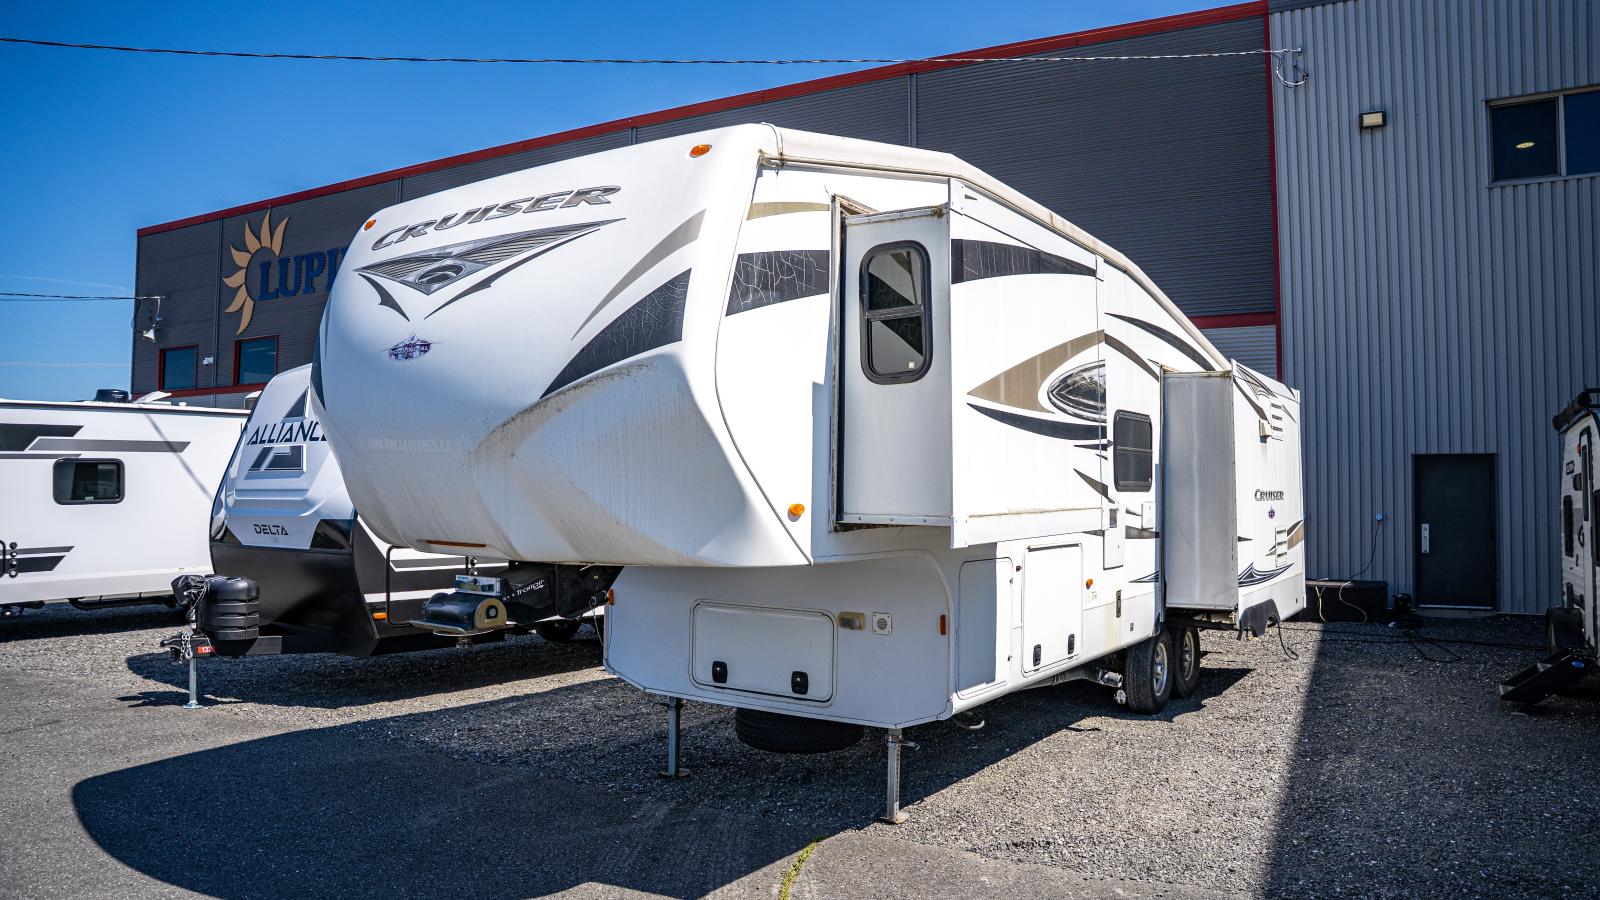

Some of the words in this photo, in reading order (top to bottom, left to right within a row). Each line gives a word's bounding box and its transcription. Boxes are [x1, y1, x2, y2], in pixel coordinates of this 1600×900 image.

[371, 185, 622, 251] CRUISER
[258, 246, 349, 302] LUPI
[247, 420, 327, 445] ALLIANC
[1254, 488, 1284, 501] CRUISER
[253, 523, 289, 536] DELTA
